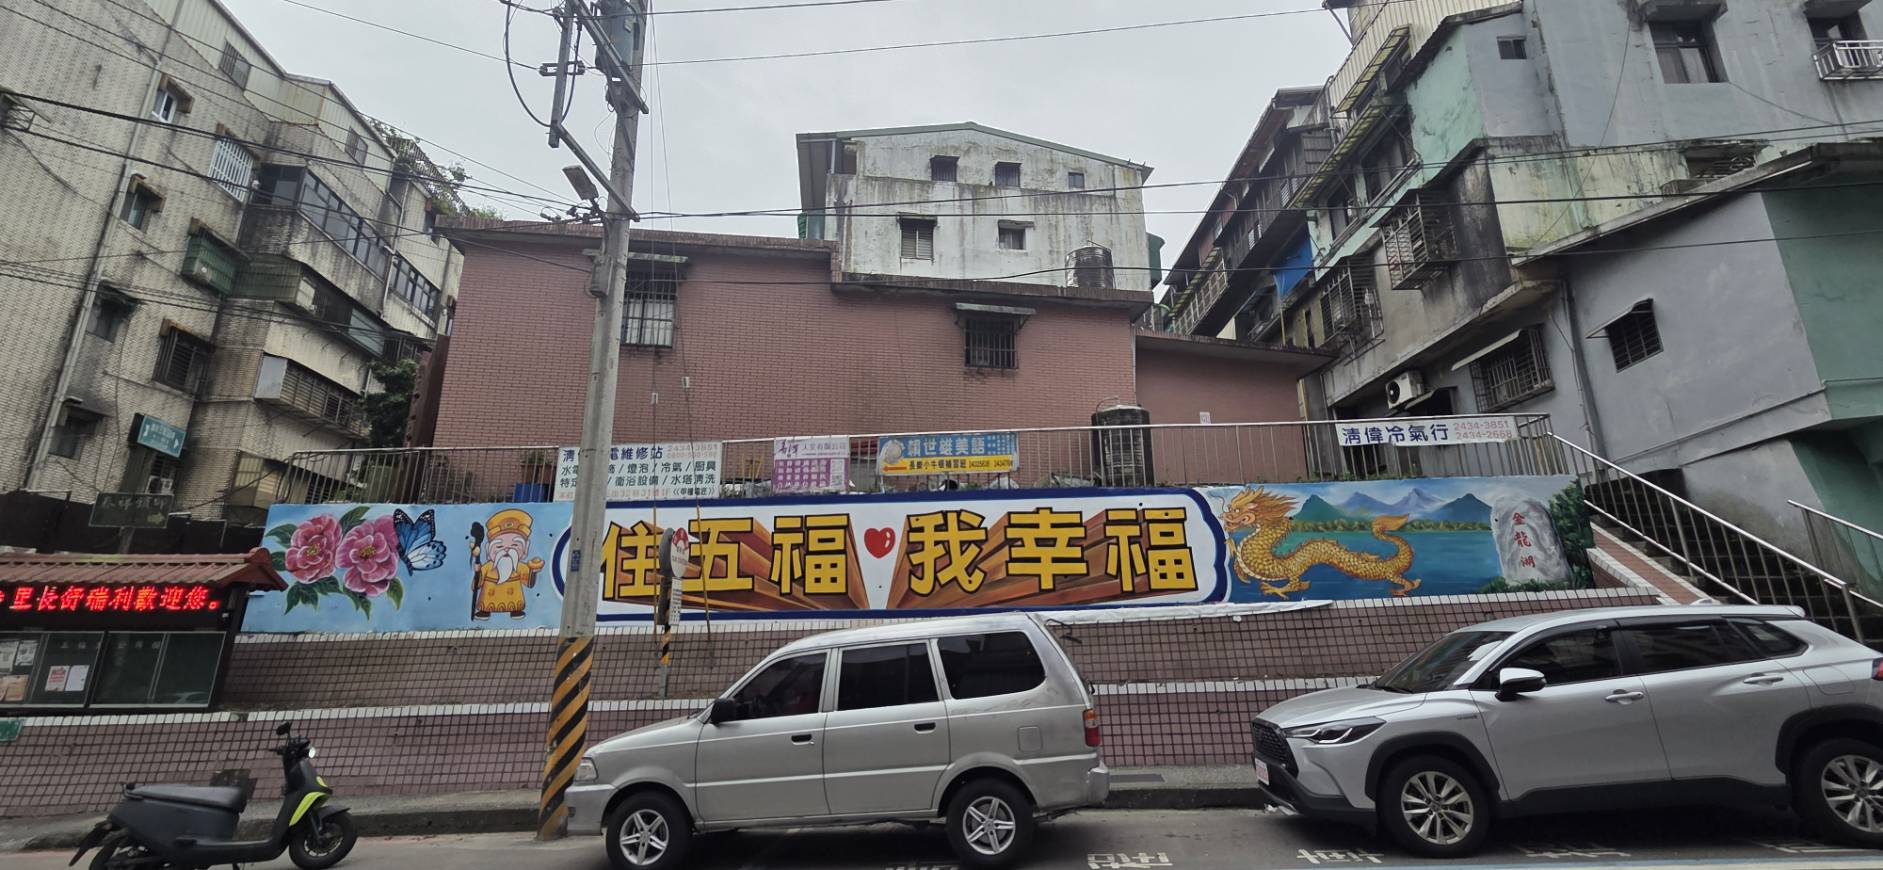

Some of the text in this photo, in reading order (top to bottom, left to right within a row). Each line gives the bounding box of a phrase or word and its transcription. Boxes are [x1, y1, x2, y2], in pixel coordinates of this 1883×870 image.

[1343, 424, 1448, 444] 清偉冷氣行
[1453, 420, 1508, 430] 2434-3851
[563, 448, 663, 462] 清電維修站
[1513, 512, 1535, 568] 金龍湖
[600, 507, 1198, 600] 住五福 我幸福
